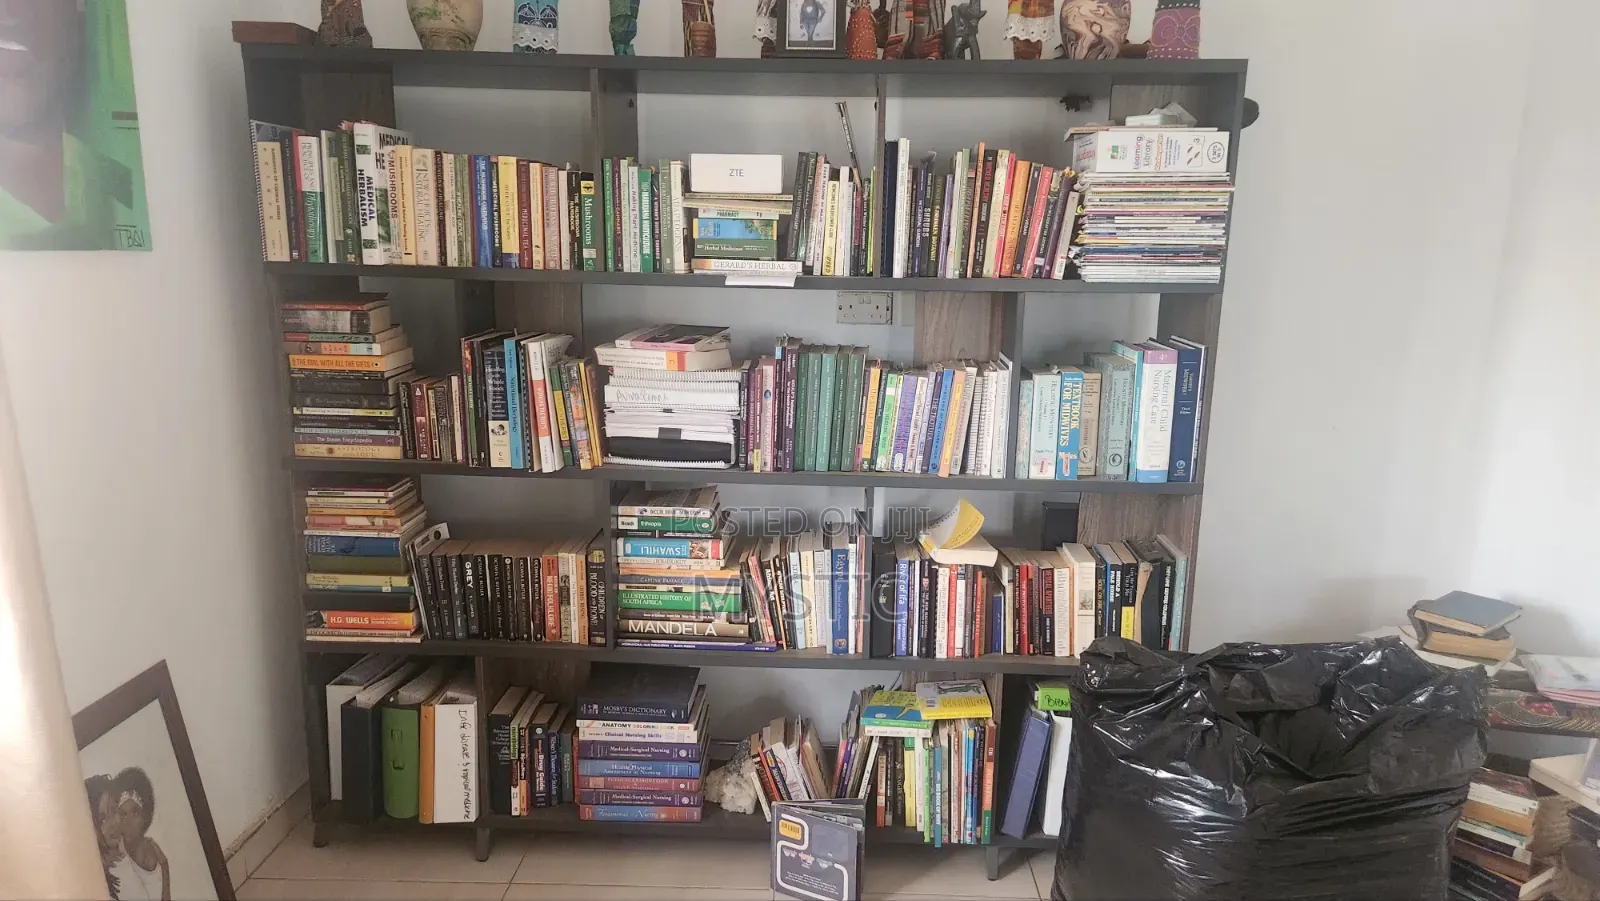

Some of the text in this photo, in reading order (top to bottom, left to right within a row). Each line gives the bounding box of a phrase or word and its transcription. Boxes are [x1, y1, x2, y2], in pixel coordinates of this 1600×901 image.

[1133, 136, 1144, 170] Learning
[1143, 139, 1154, 166] Library
[729, 168, 744, 177] ZTE
[357, 168, 368, 227] HERBALISM
[366, 176, 376, 221] MEDICAL
[388, 160, 399, 219] MUSHROOMS
[416, 172, 426, 243] NATURAL HEALING
[584, 198, 593, 244] Mushrooms
[922, 208, 931, 238] SHRUBS
[296, 358, 306, 366] THE
[1070, 382, 1082, 429] TEXTBOOK
[1150, 370, 1162, 424] Nursing Care
[1160, 370, 1172, 432] Maternal Child
[559, 418, 568, 440] HERBS
[1060, 382, 1073, 446] FOR MIDWIVES
[640, 546, 682, 555] SWAHILI
[465, 562, 474, 589] GREY
[590, 572, 598, 598] BLOOD
[899, 584, 906, 593] of
[547, 594, 556, 627] FOLKLORE
[898, 594, 906, 604] Ifa
[628, 620, 718, 636] MANDELA
